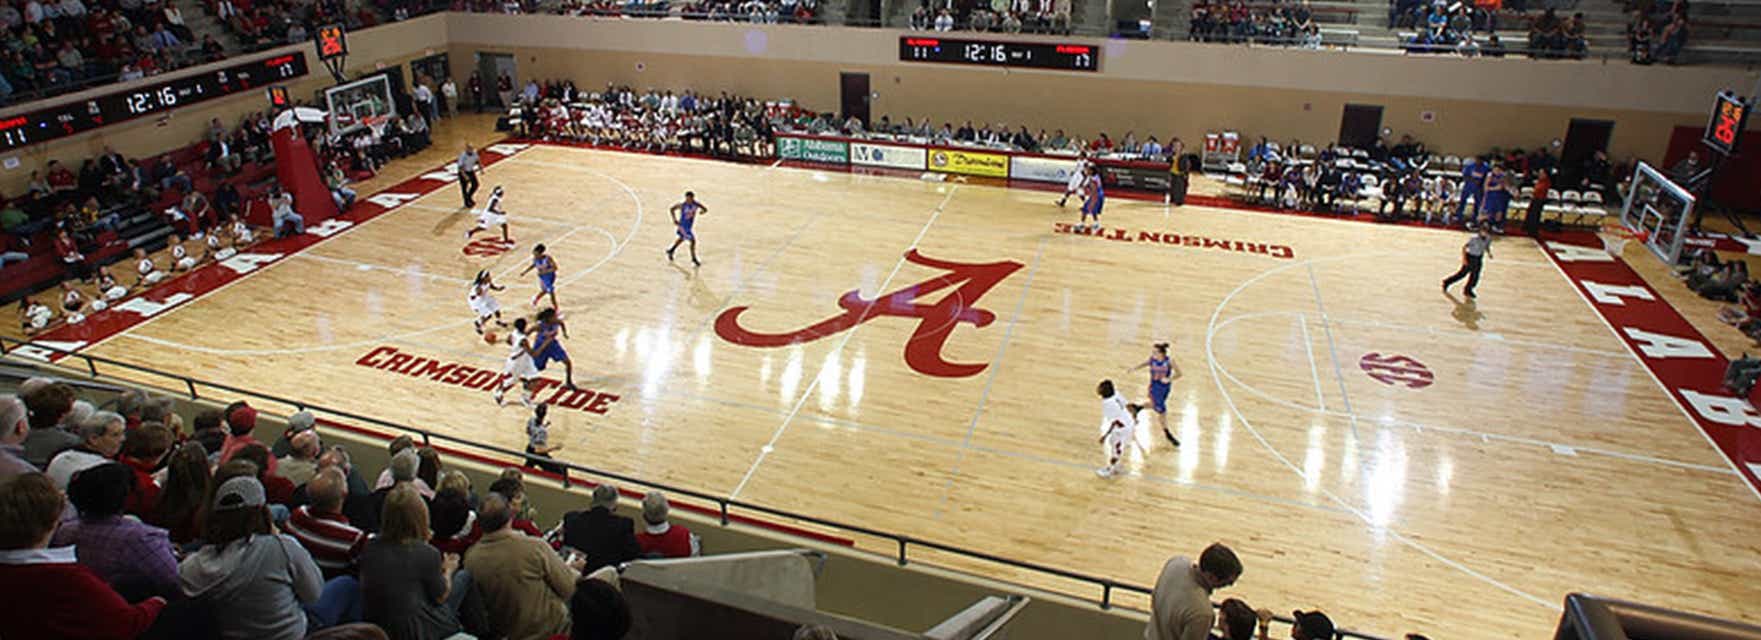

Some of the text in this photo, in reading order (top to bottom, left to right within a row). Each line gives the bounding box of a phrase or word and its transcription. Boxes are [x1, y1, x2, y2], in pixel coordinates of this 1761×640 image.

[964, 44, 1006, 62] 12:16
[126, 86, 176, 113] 12:16
[1137, 230, 1294, 258] CRIMSON
[528, 378, 621, 415] TIDE
